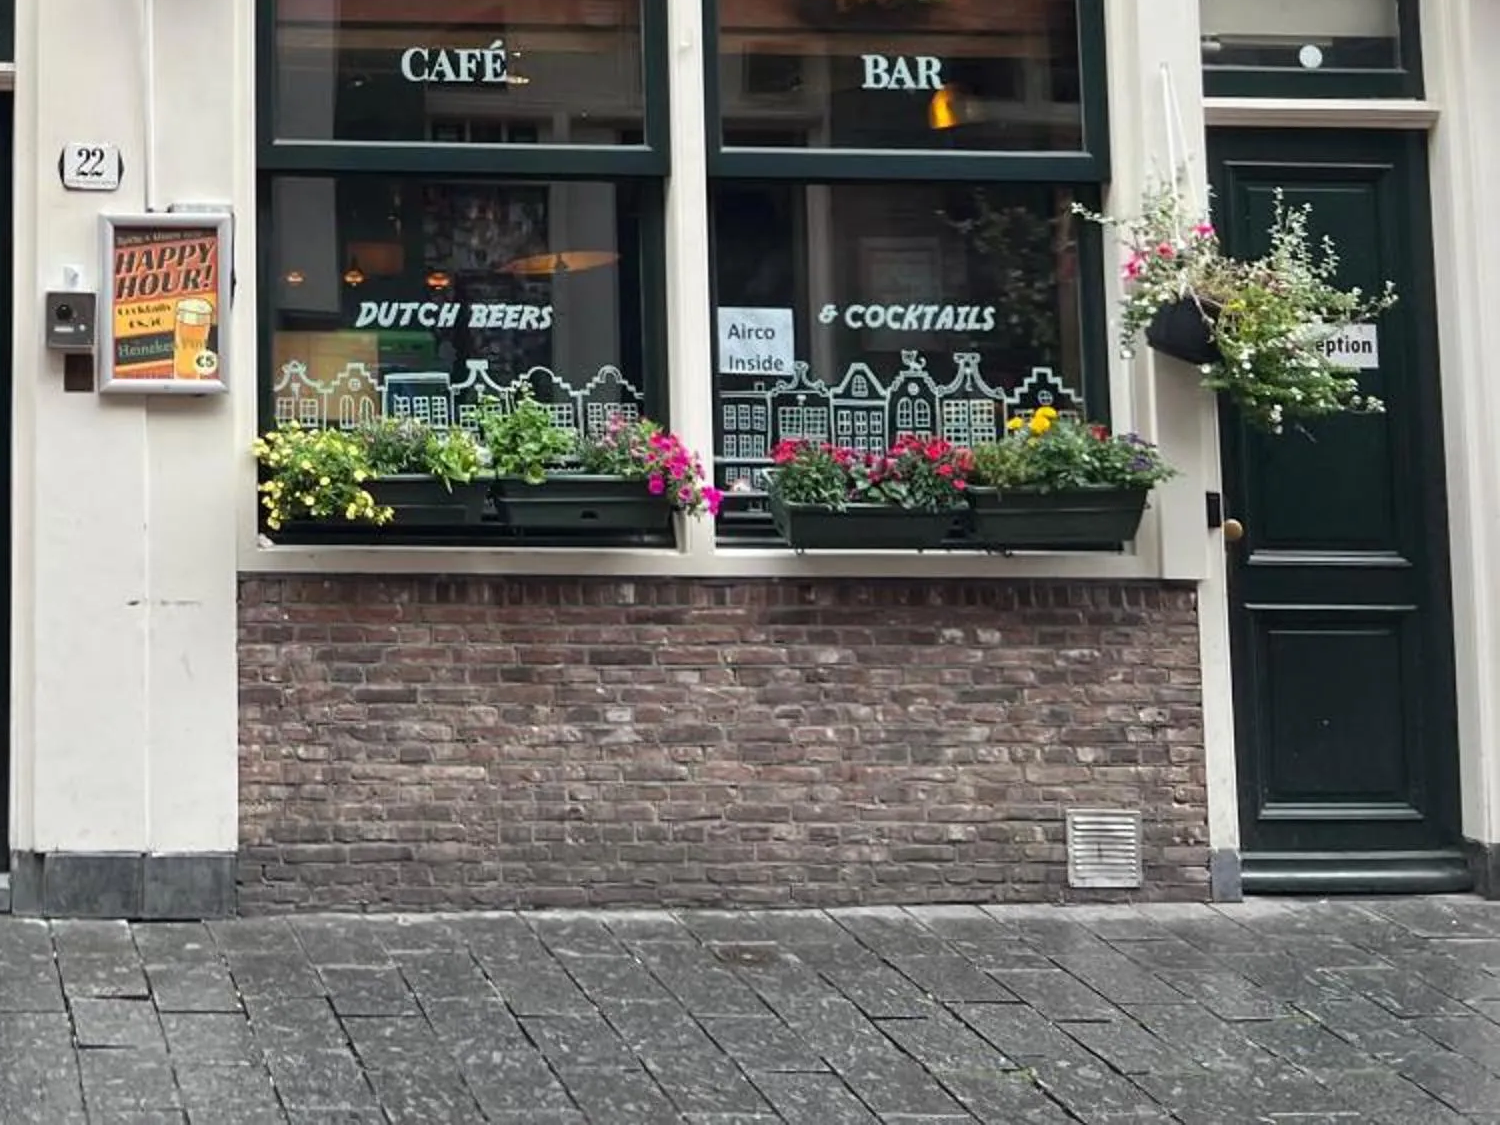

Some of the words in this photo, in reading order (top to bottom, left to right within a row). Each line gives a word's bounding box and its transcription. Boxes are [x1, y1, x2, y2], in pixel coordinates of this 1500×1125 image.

[401, 39, 507, 83] CAFÉ
[861, 54, 944, 90] BAR
[76, 148, 105, 177] 22
[114, 241, 215, 274] HAPPY
[115, 264, 213, 300] HOUR!
[355, 301, 461, 328] DUTCH
[467, 303, 554, 330] BEERS
[818, 305, 838, 323] &
[844, 304, 996, 331] COCKTAILS
[727, 323, 775, 340] Airco
[1315, 335, 1373, 357] eption
[729, 355, 784, 372] Inside
